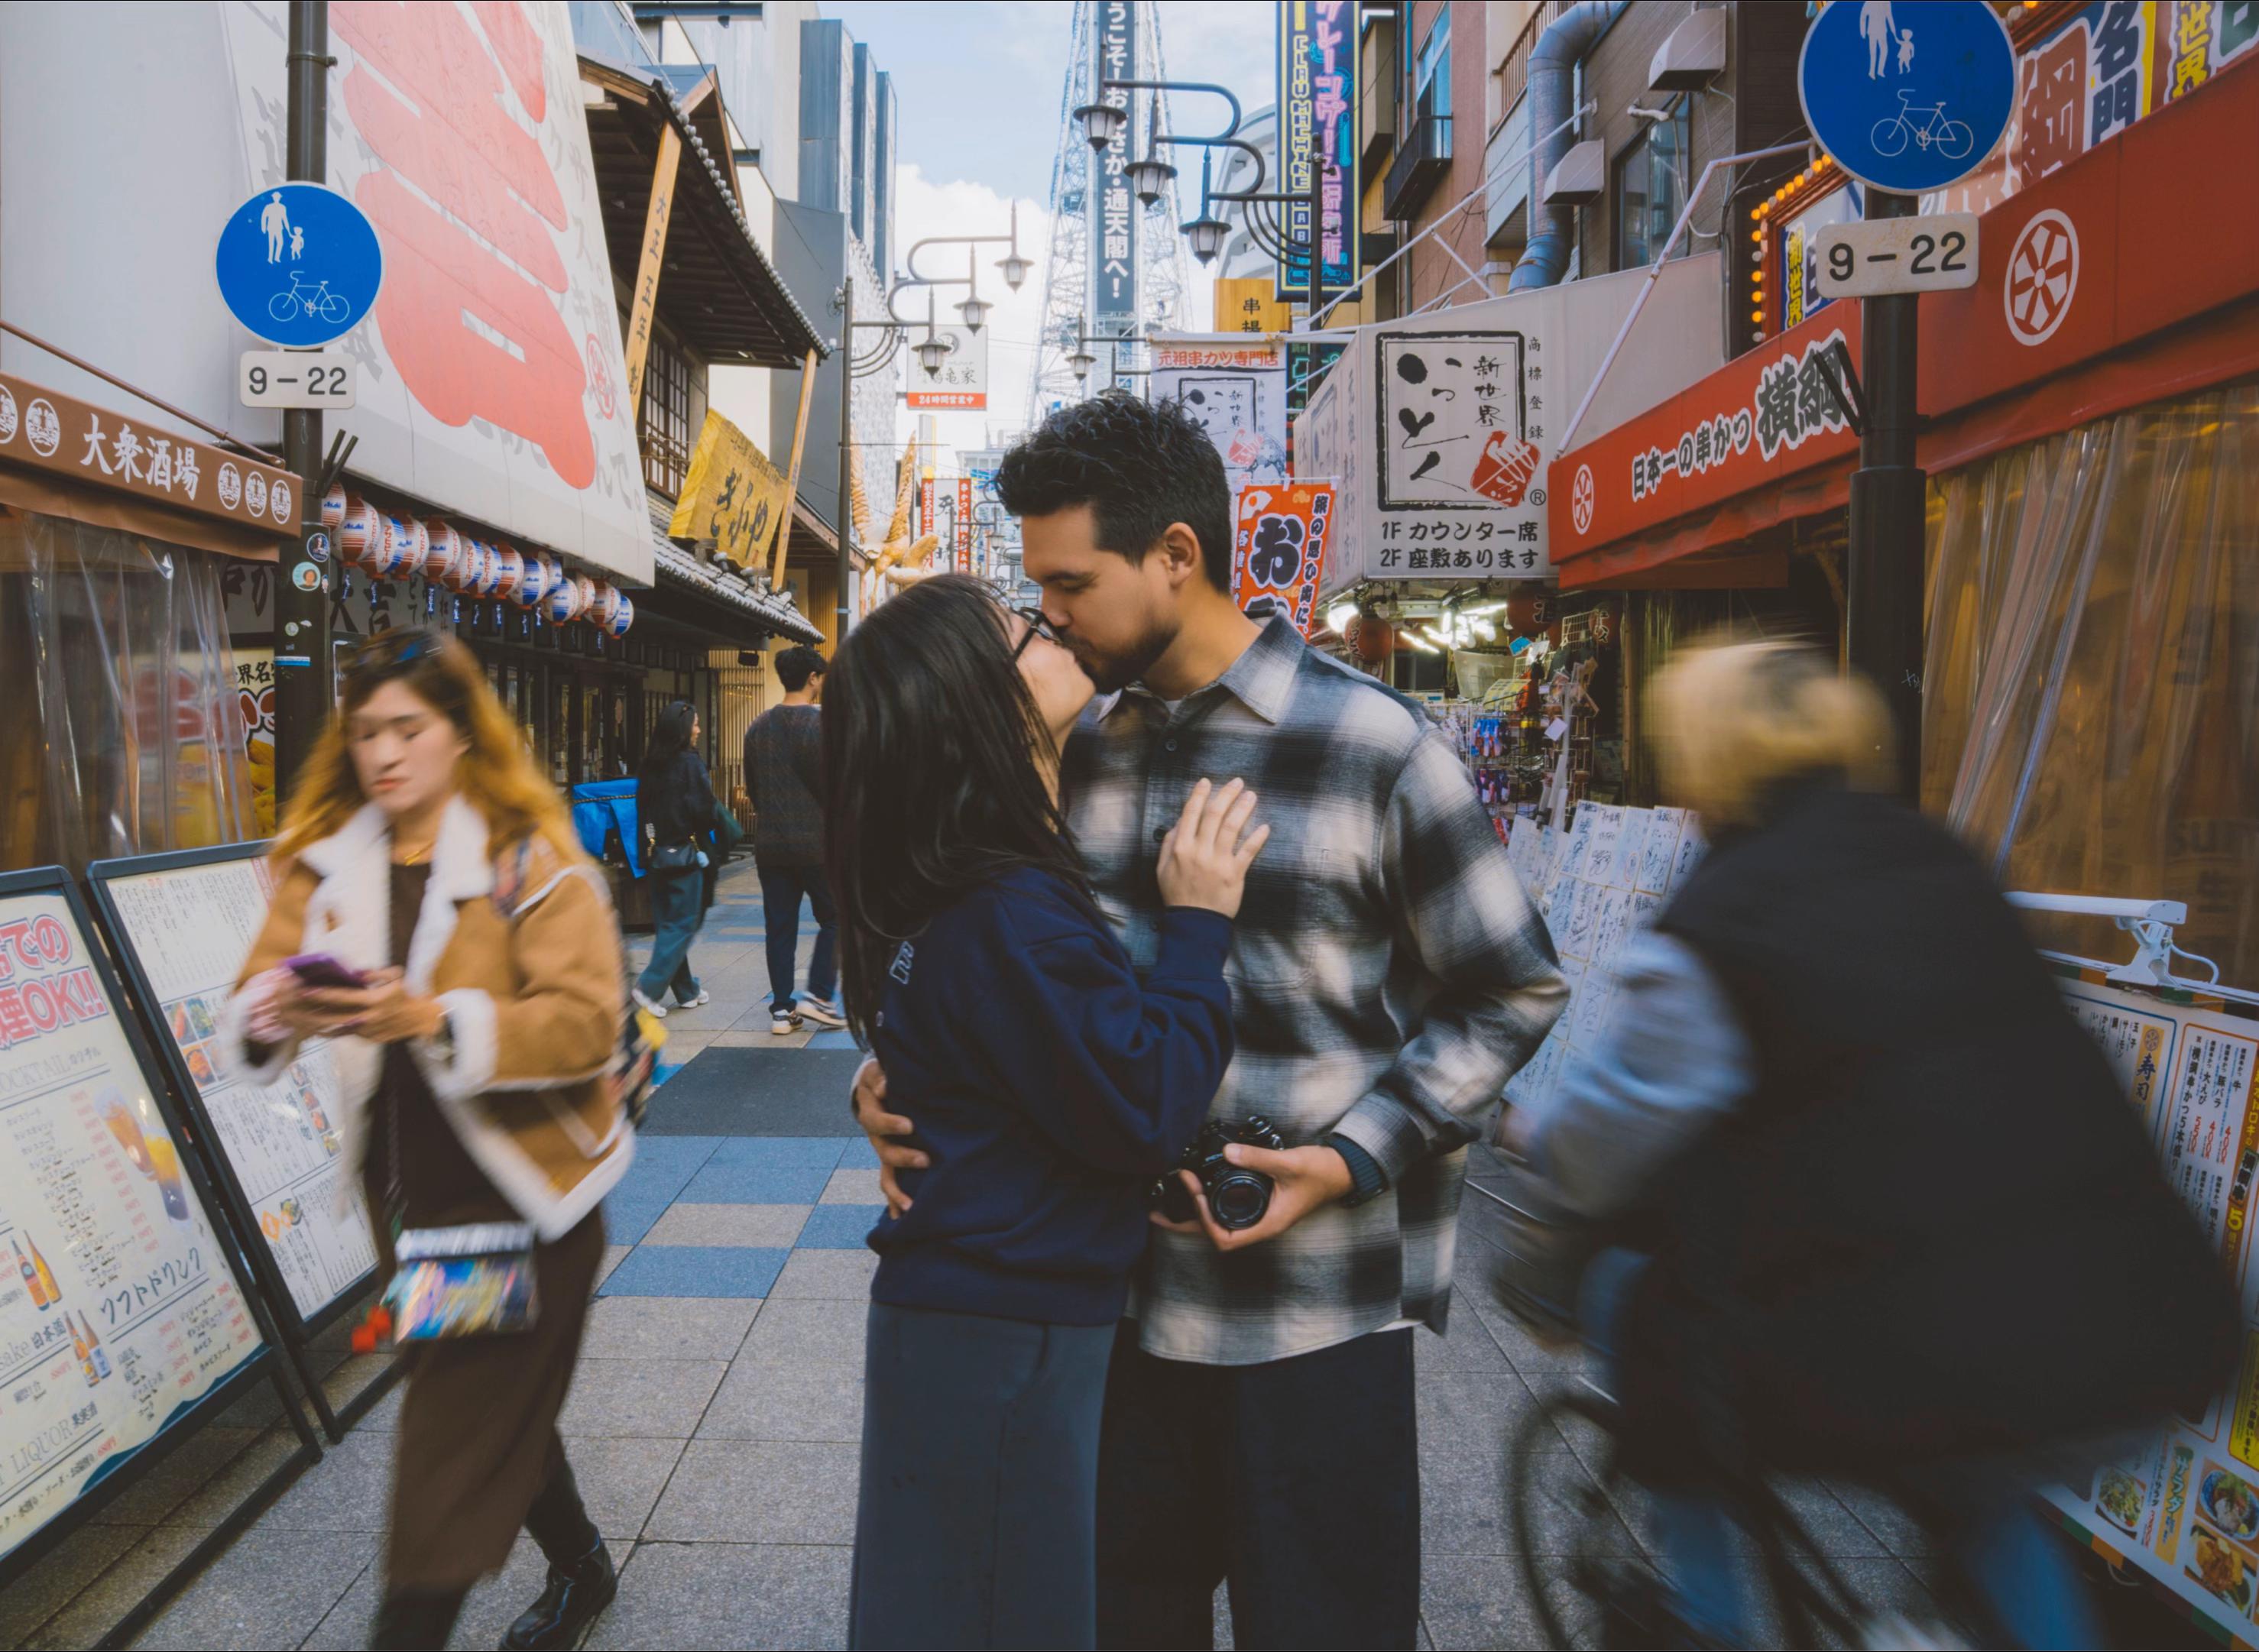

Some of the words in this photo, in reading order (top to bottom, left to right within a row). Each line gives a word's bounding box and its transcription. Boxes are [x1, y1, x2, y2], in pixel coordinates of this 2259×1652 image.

[1473, 356, 1506, 426] 新世界
[1528, 336, 1544, 439] 商標登録
[1632, 410, 1751, 500] 日本一の串かつ
[1757, 332, 1849, 460] 横綱
[80, 413, 200, 500] 大衆酒場
[1380, 549, 1402, 567] 2F
[1408, 548, 1538, 569] 座敷あります
[1382, 522, 1402, 540] 1F
[1408, 521, 1538, 542] カウンター席
[2136, 1052, 2156, 1101] 寿司
[10, 1419, 73, 1474] LIQUOR
